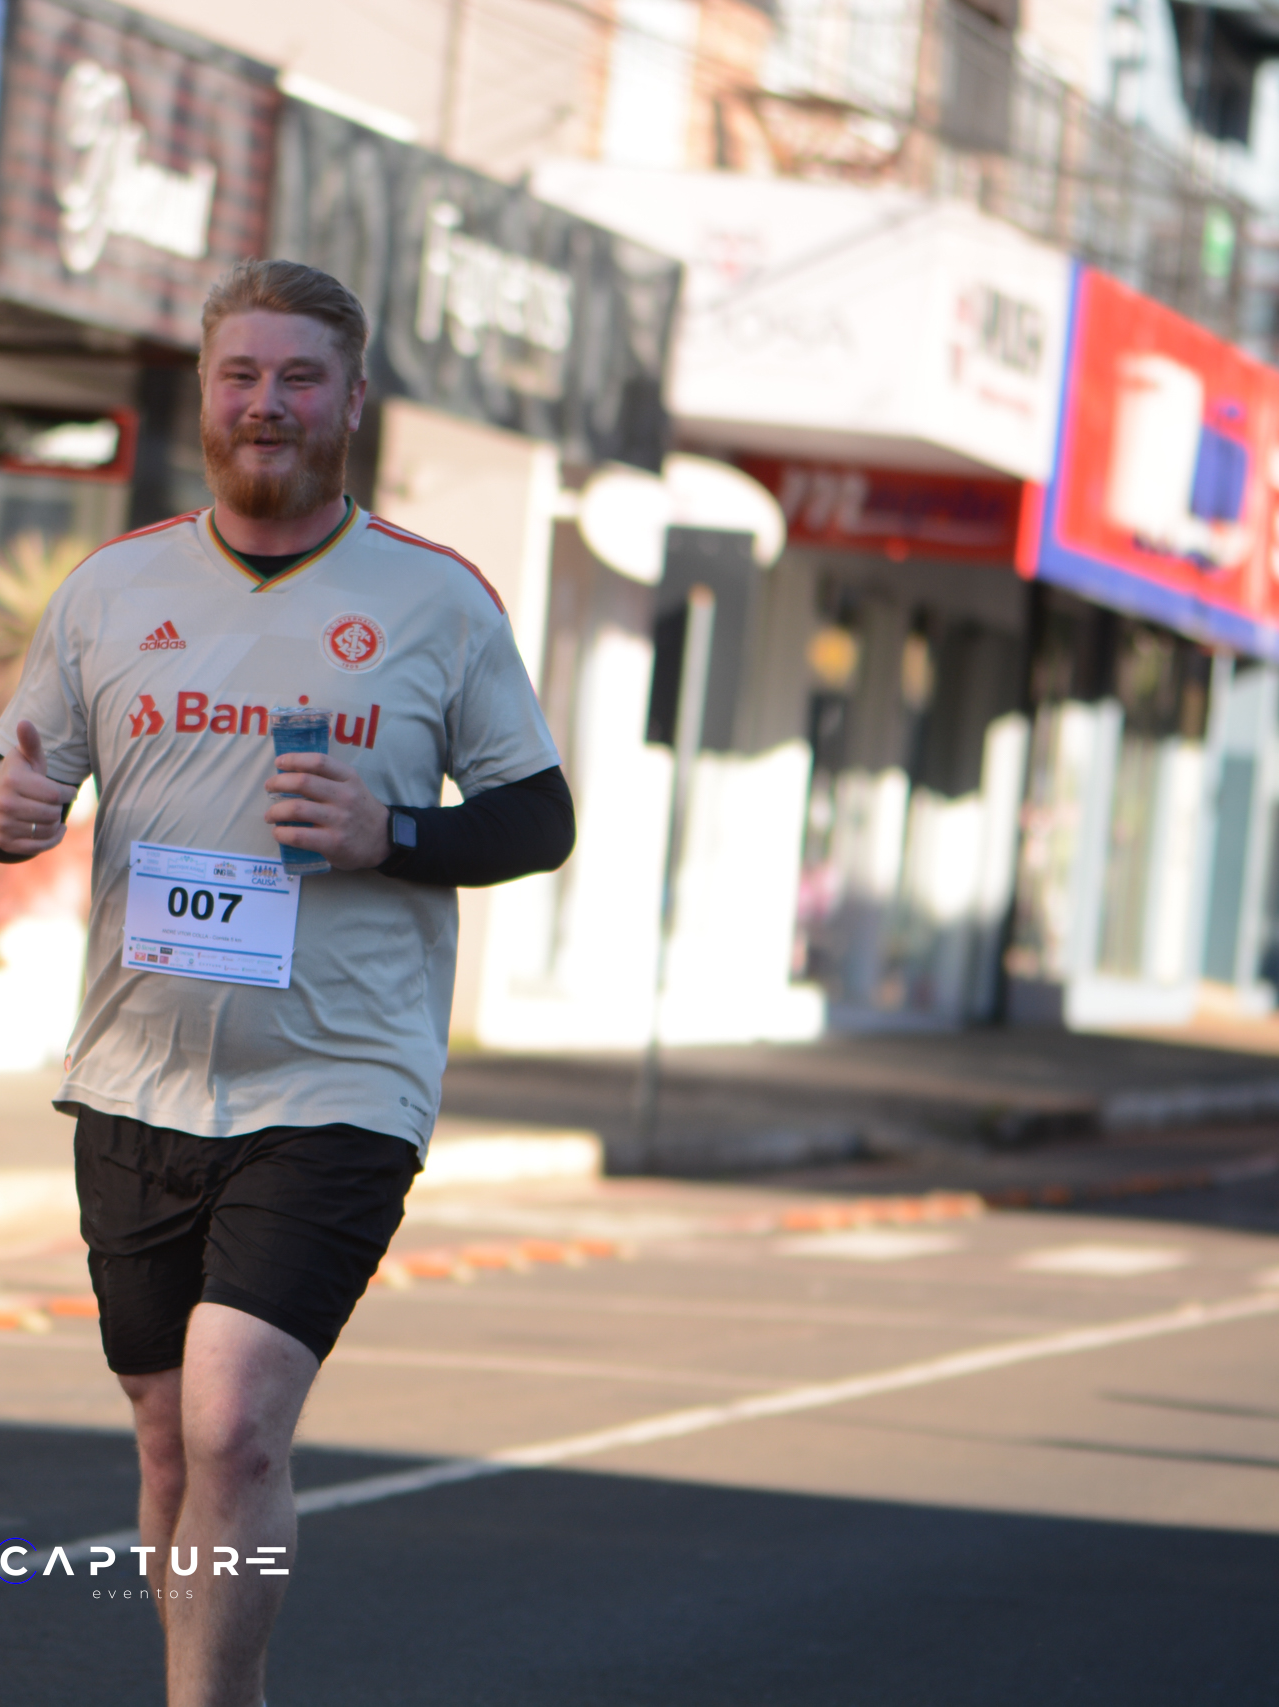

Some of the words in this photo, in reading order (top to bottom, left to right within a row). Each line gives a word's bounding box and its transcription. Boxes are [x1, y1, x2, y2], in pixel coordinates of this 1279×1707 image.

[139, 638, 187, 651] adidas
[175, 691, 381, 749] Banul
[251, 877, 277, 886] CAUSA
[167, 886, 243, 923] 007
